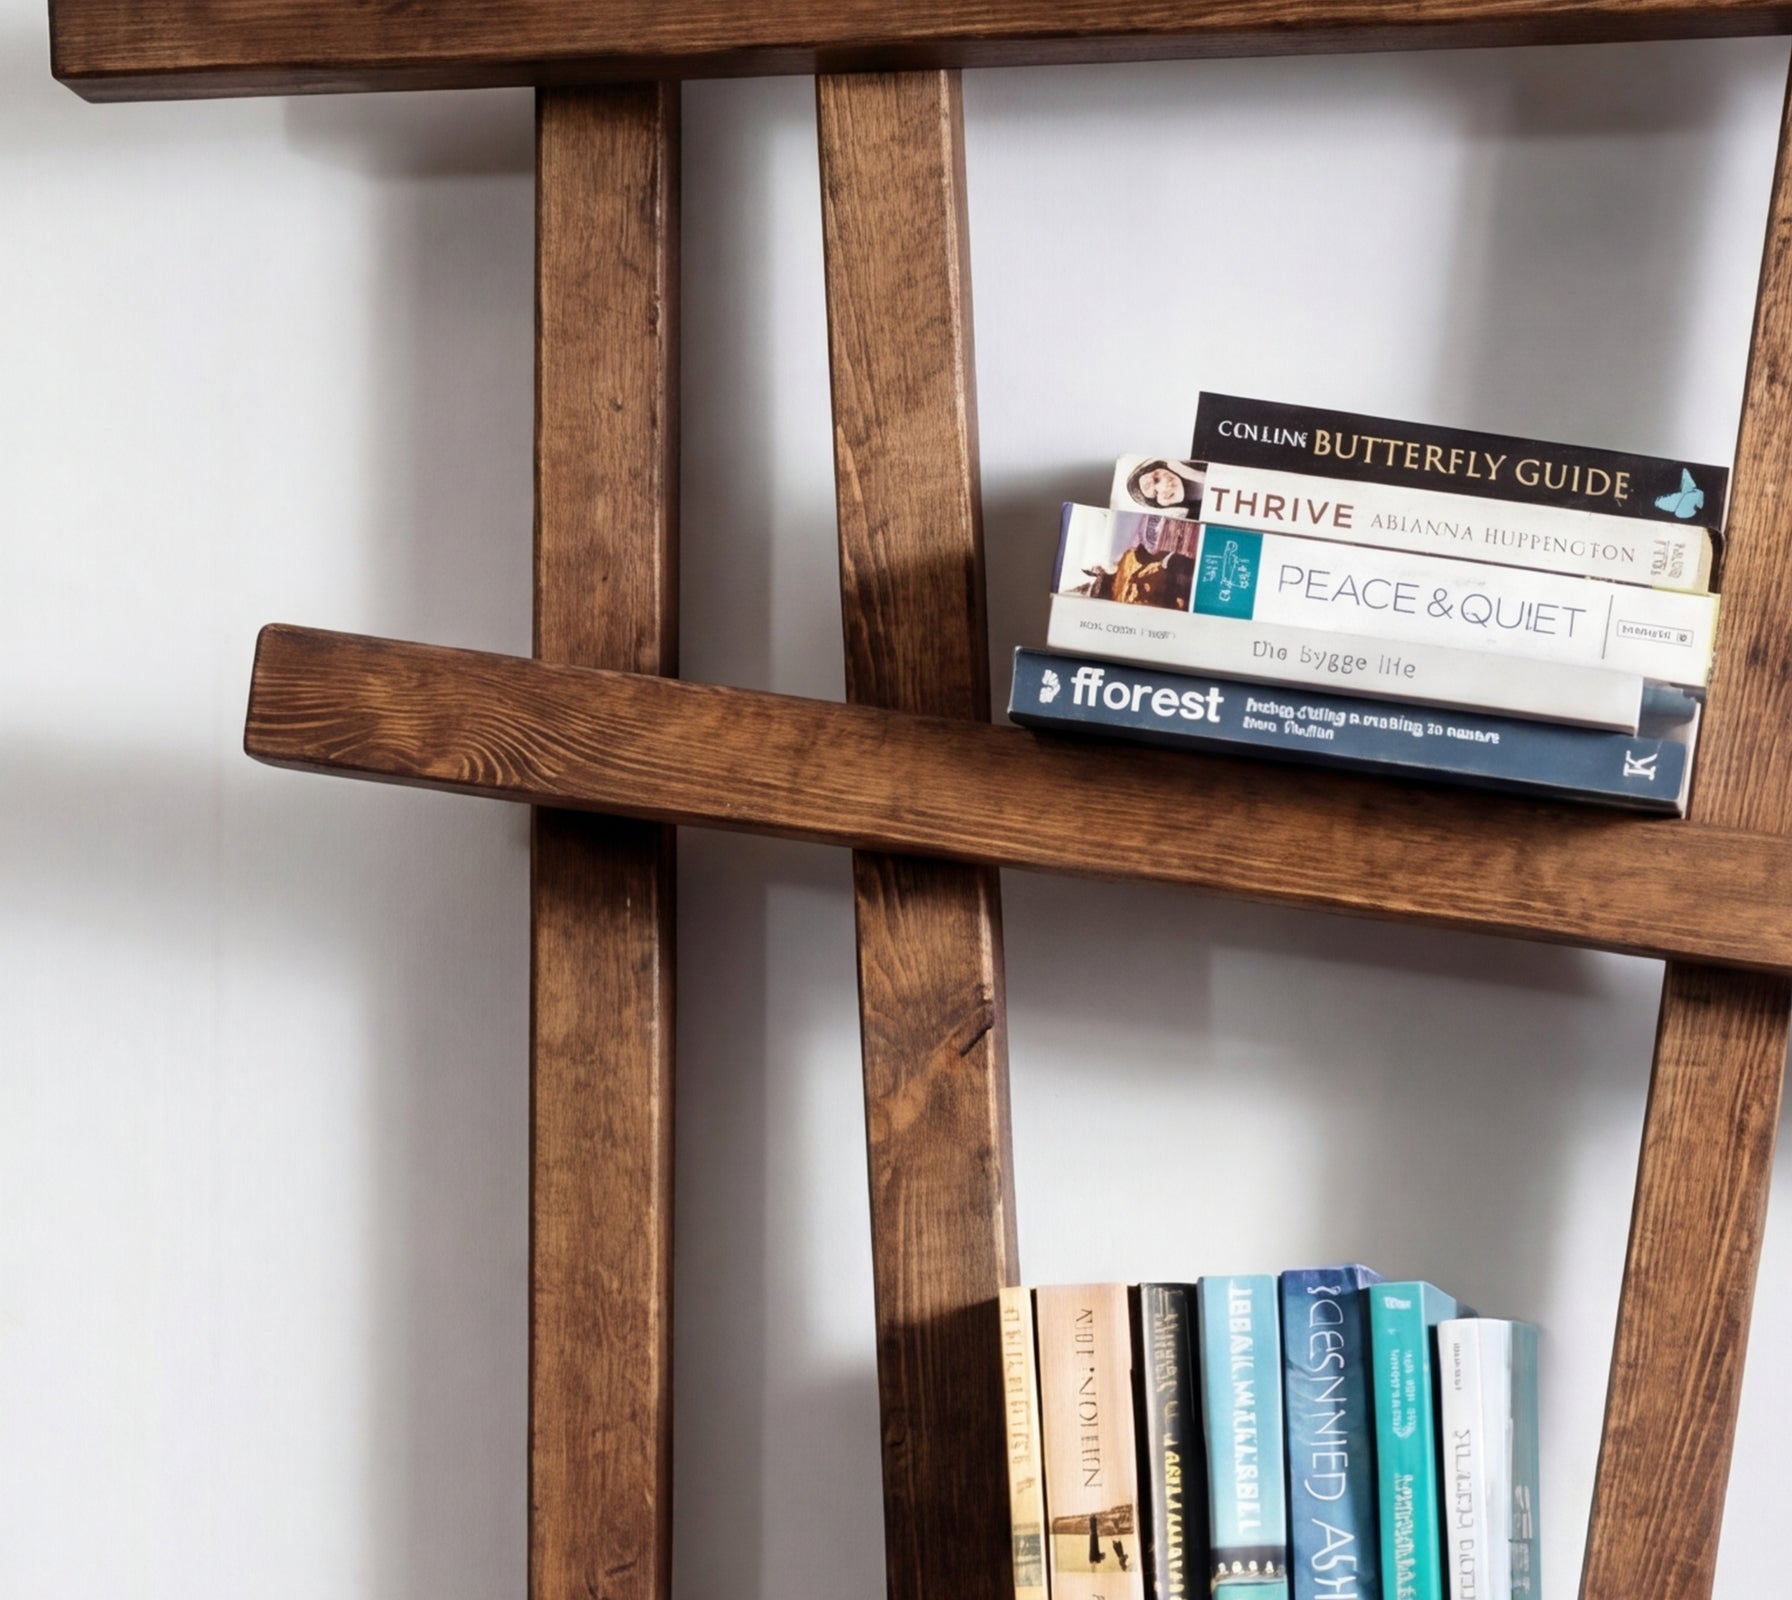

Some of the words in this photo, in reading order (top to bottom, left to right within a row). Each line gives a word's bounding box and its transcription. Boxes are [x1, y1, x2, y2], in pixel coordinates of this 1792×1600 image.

[1313, 428, 1507, 482] BUTTERFLY
[1514, 458, 1632, 500] GUIDE
[1209, 486, 1355, 529] THRIVE
[1277, 563, 1421, 615] PEACE
[1426, 587, 1454, 620] &
[1460, 592, 1588, 639] QUIET
[1070, 665, 1226, 724] fforest
